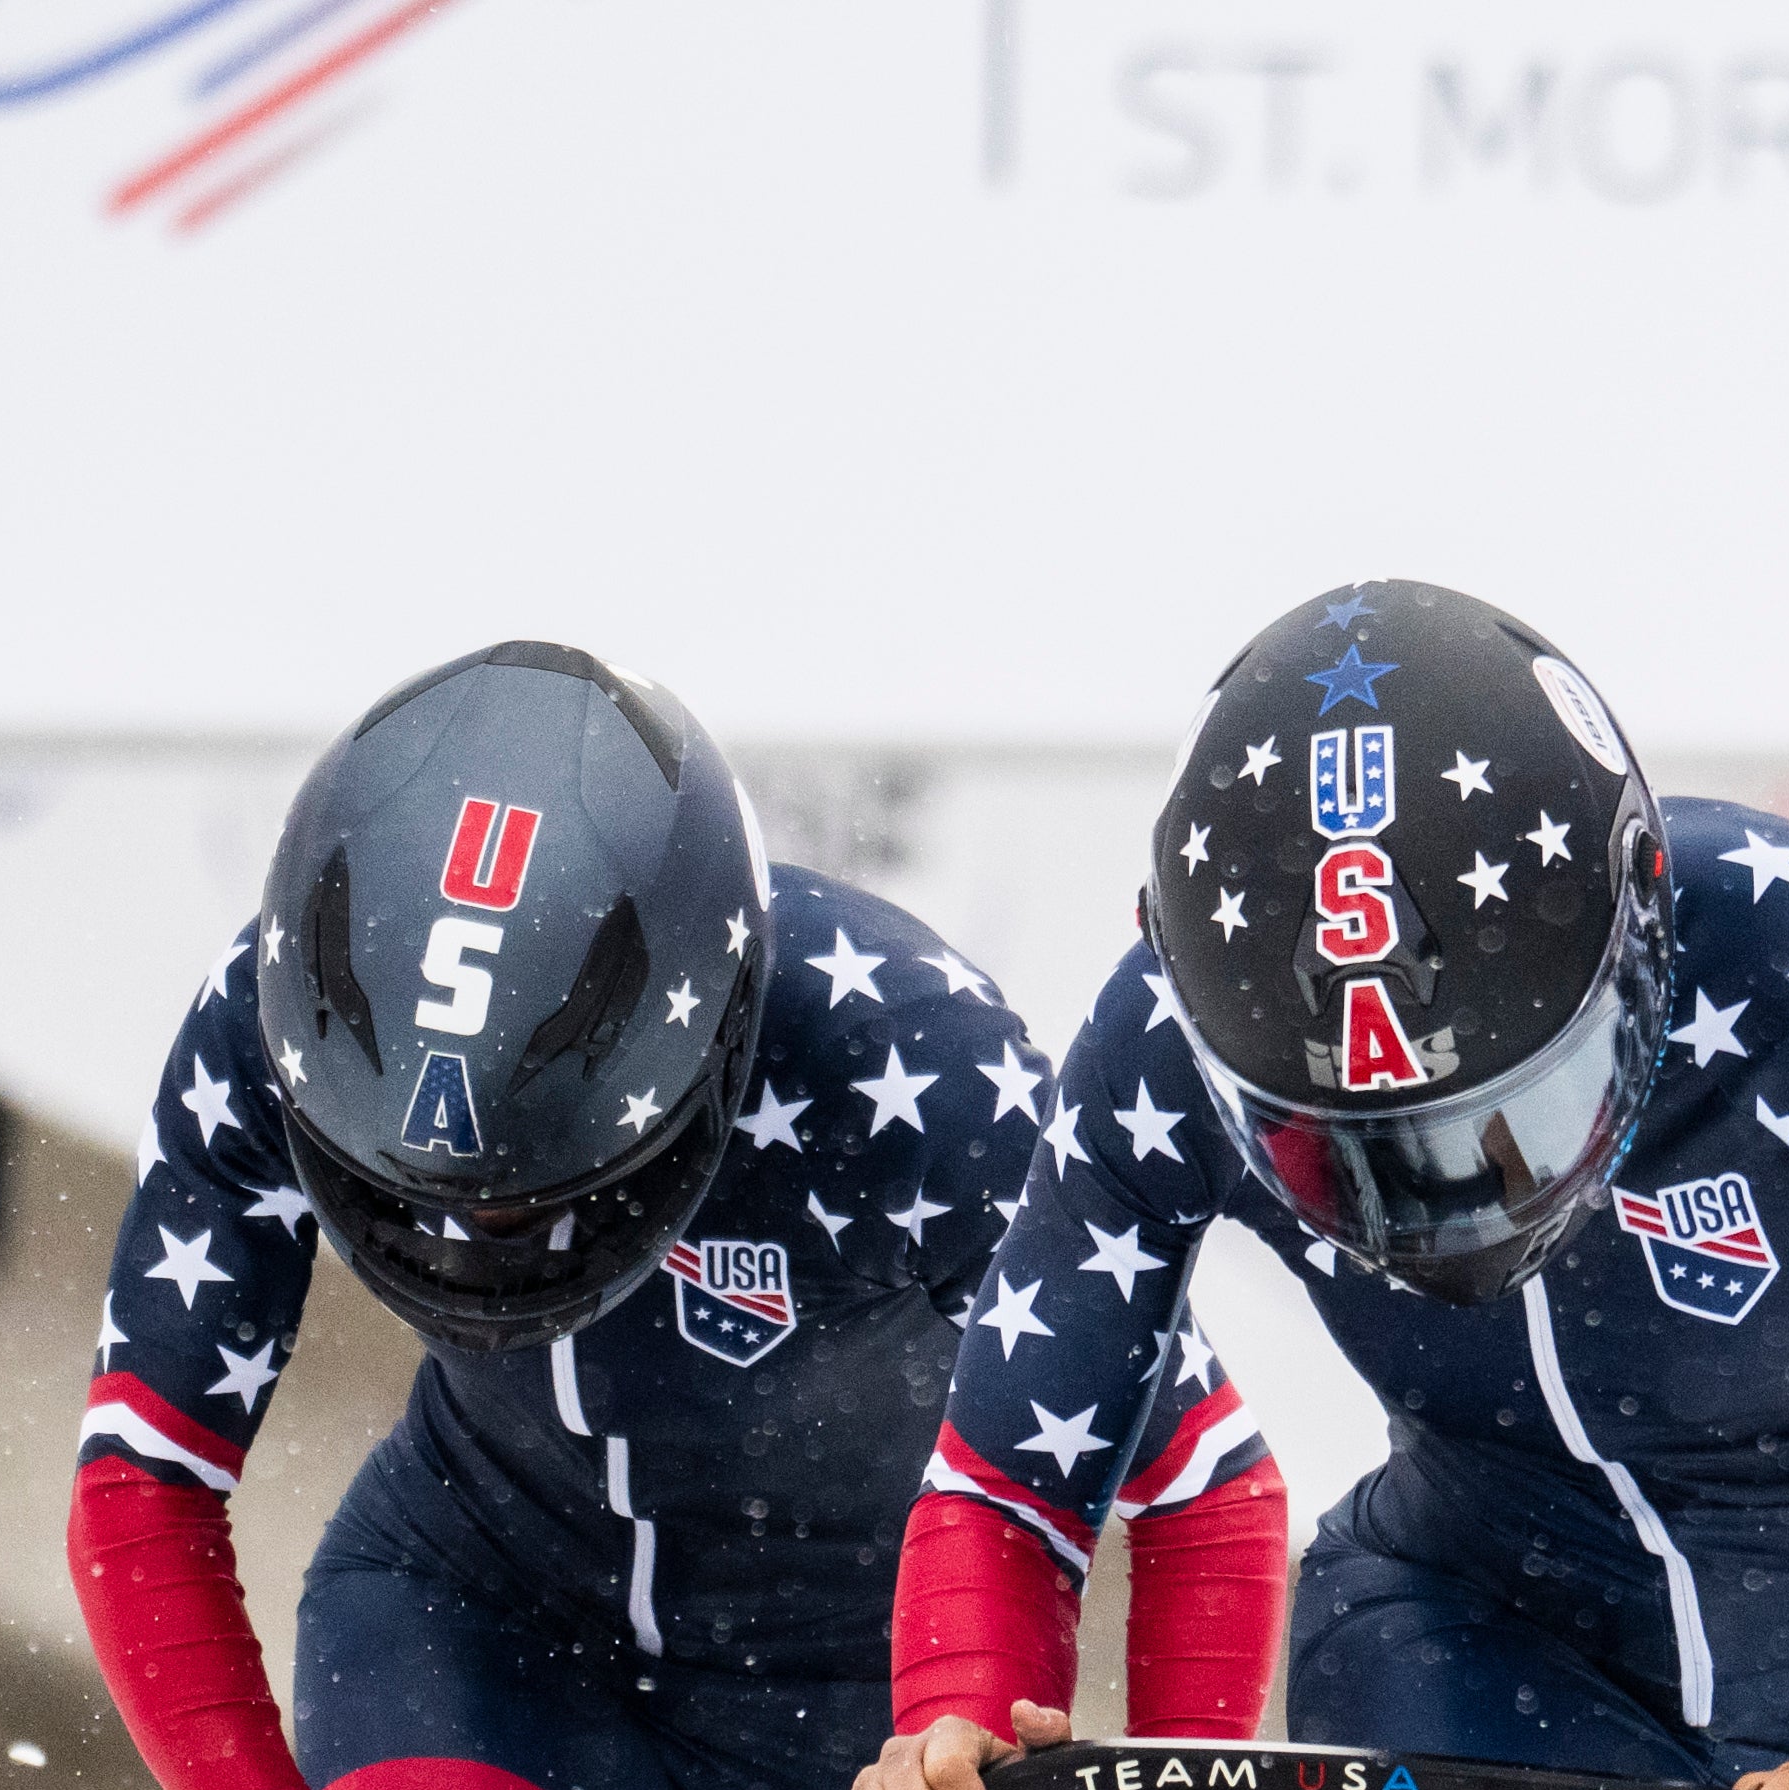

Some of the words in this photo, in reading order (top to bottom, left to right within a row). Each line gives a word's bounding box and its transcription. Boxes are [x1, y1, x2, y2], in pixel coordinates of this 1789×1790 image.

[1115, 45, 1355, 198] ST.
[401, 797, 543, 1157] USA
[1310, 725, 1427, 1091] USA
[707, 1246, 783, 1291] USA
[1665, 1180, 1751, 1240] USA
